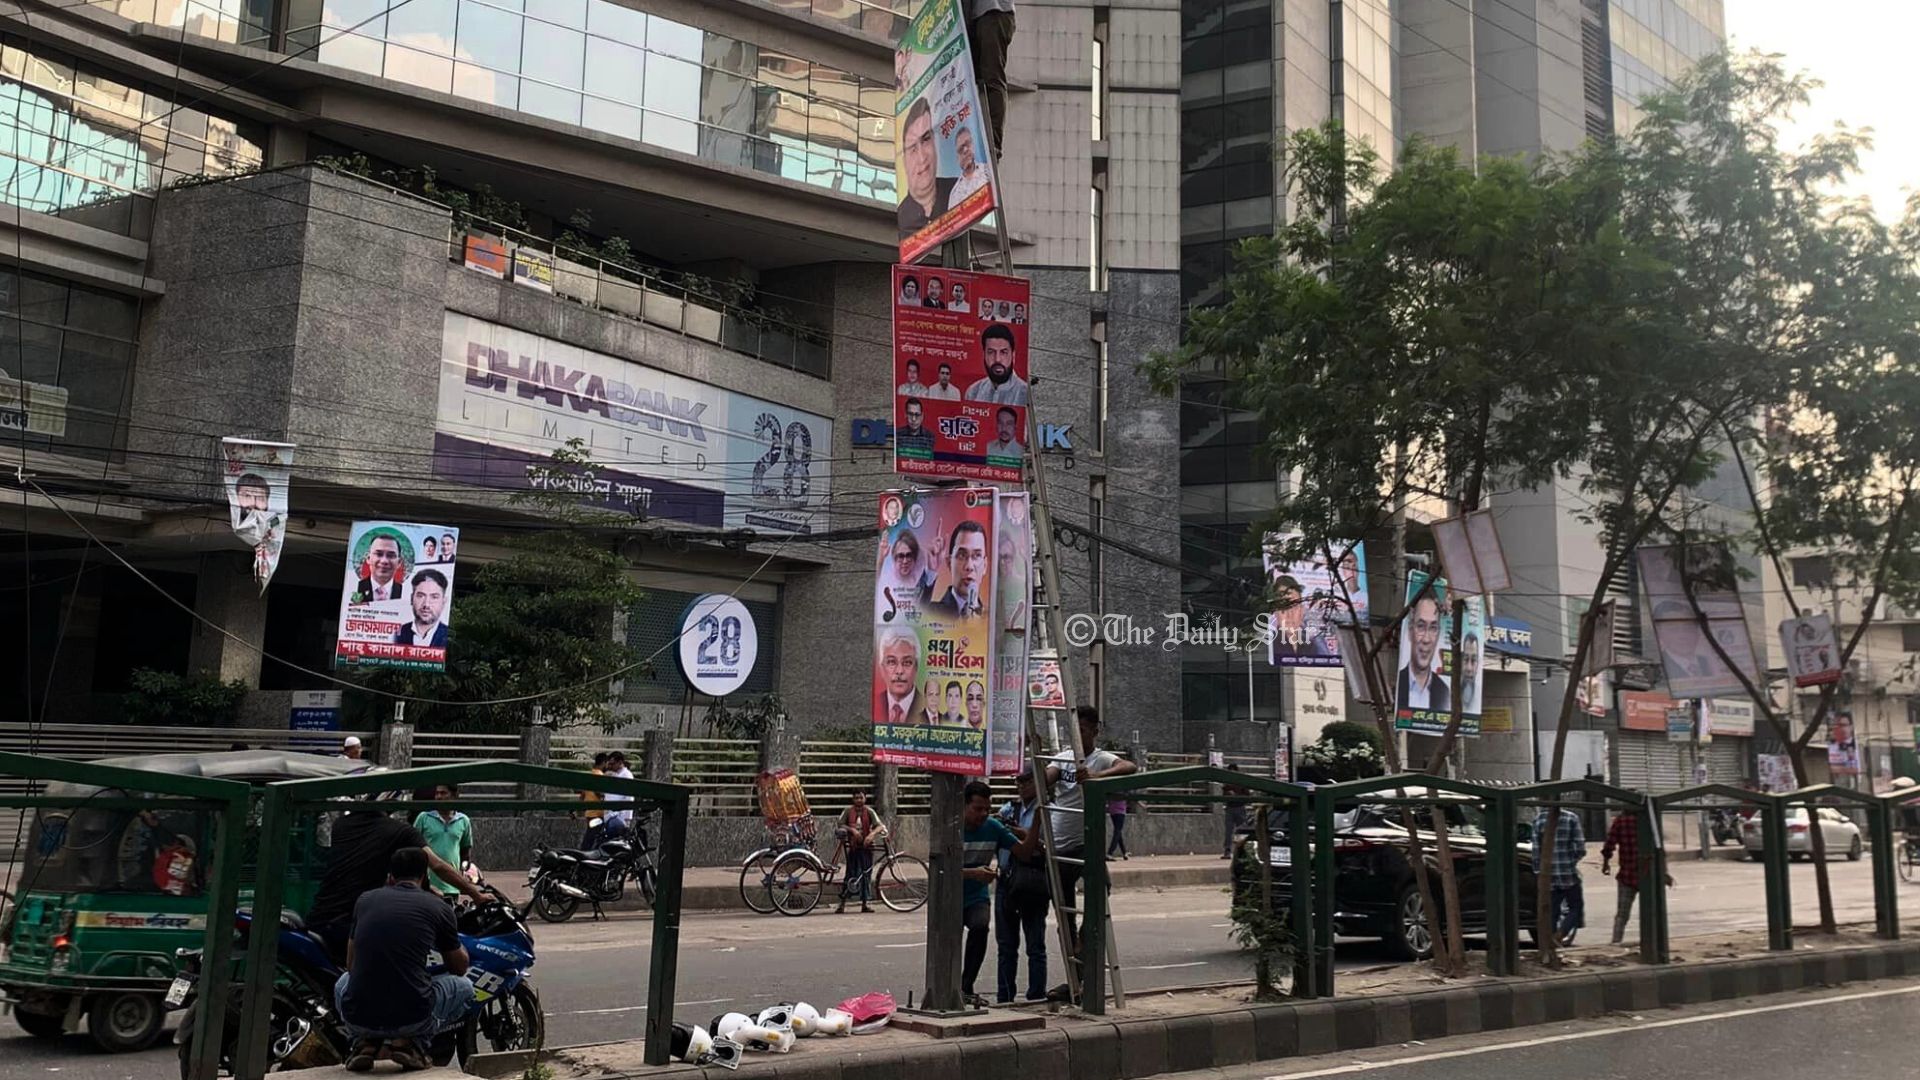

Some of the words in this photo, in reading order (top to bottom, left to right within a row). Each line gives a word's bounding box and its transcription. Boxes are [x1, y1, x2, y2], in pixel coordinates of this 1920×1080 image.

[462, 399, 707, 472] LIMITED
[938, 416, 979, 440] মুক্তি
[959, 441, 976, 452] চাই
[752, 413, 812, 507] 28
[346, 619, 401, 636] জনসমাবেশ
[369, 643, 404, 656] কামাল
[409, 647, 444, 659] রাসেল
[697, 615, 742, 666] 28
